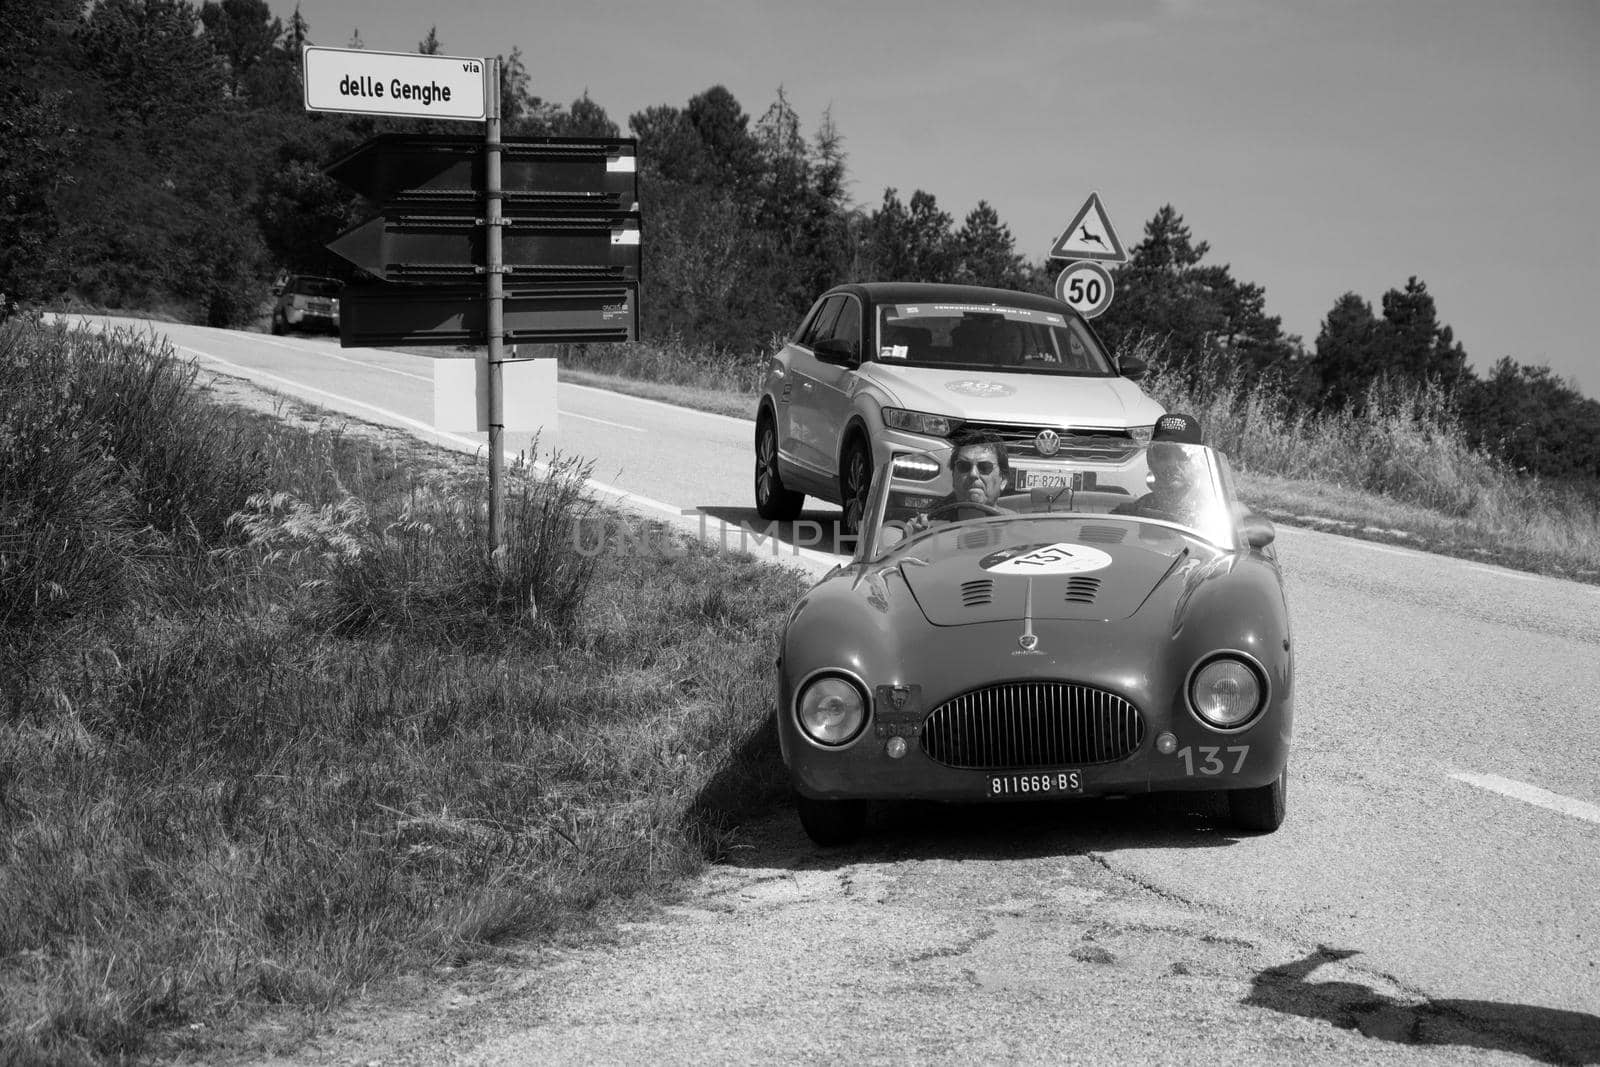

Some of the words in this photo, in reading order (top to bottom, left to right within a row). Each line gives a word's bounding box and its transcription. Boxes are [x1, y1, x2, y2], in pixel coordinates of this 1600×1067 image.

[462, 62, 479, 73] via
[340, 74, 384, 97] delle
[391, 78, 451, 105] Genghe
[1069, 278, 1101, 304] 50
[1014, 547, 1074, 566] 137
[1177, 744, 1250, 776] 137
[992, 775, 1051, 793] 811668
[1058, 773, 1079, 790] BS
